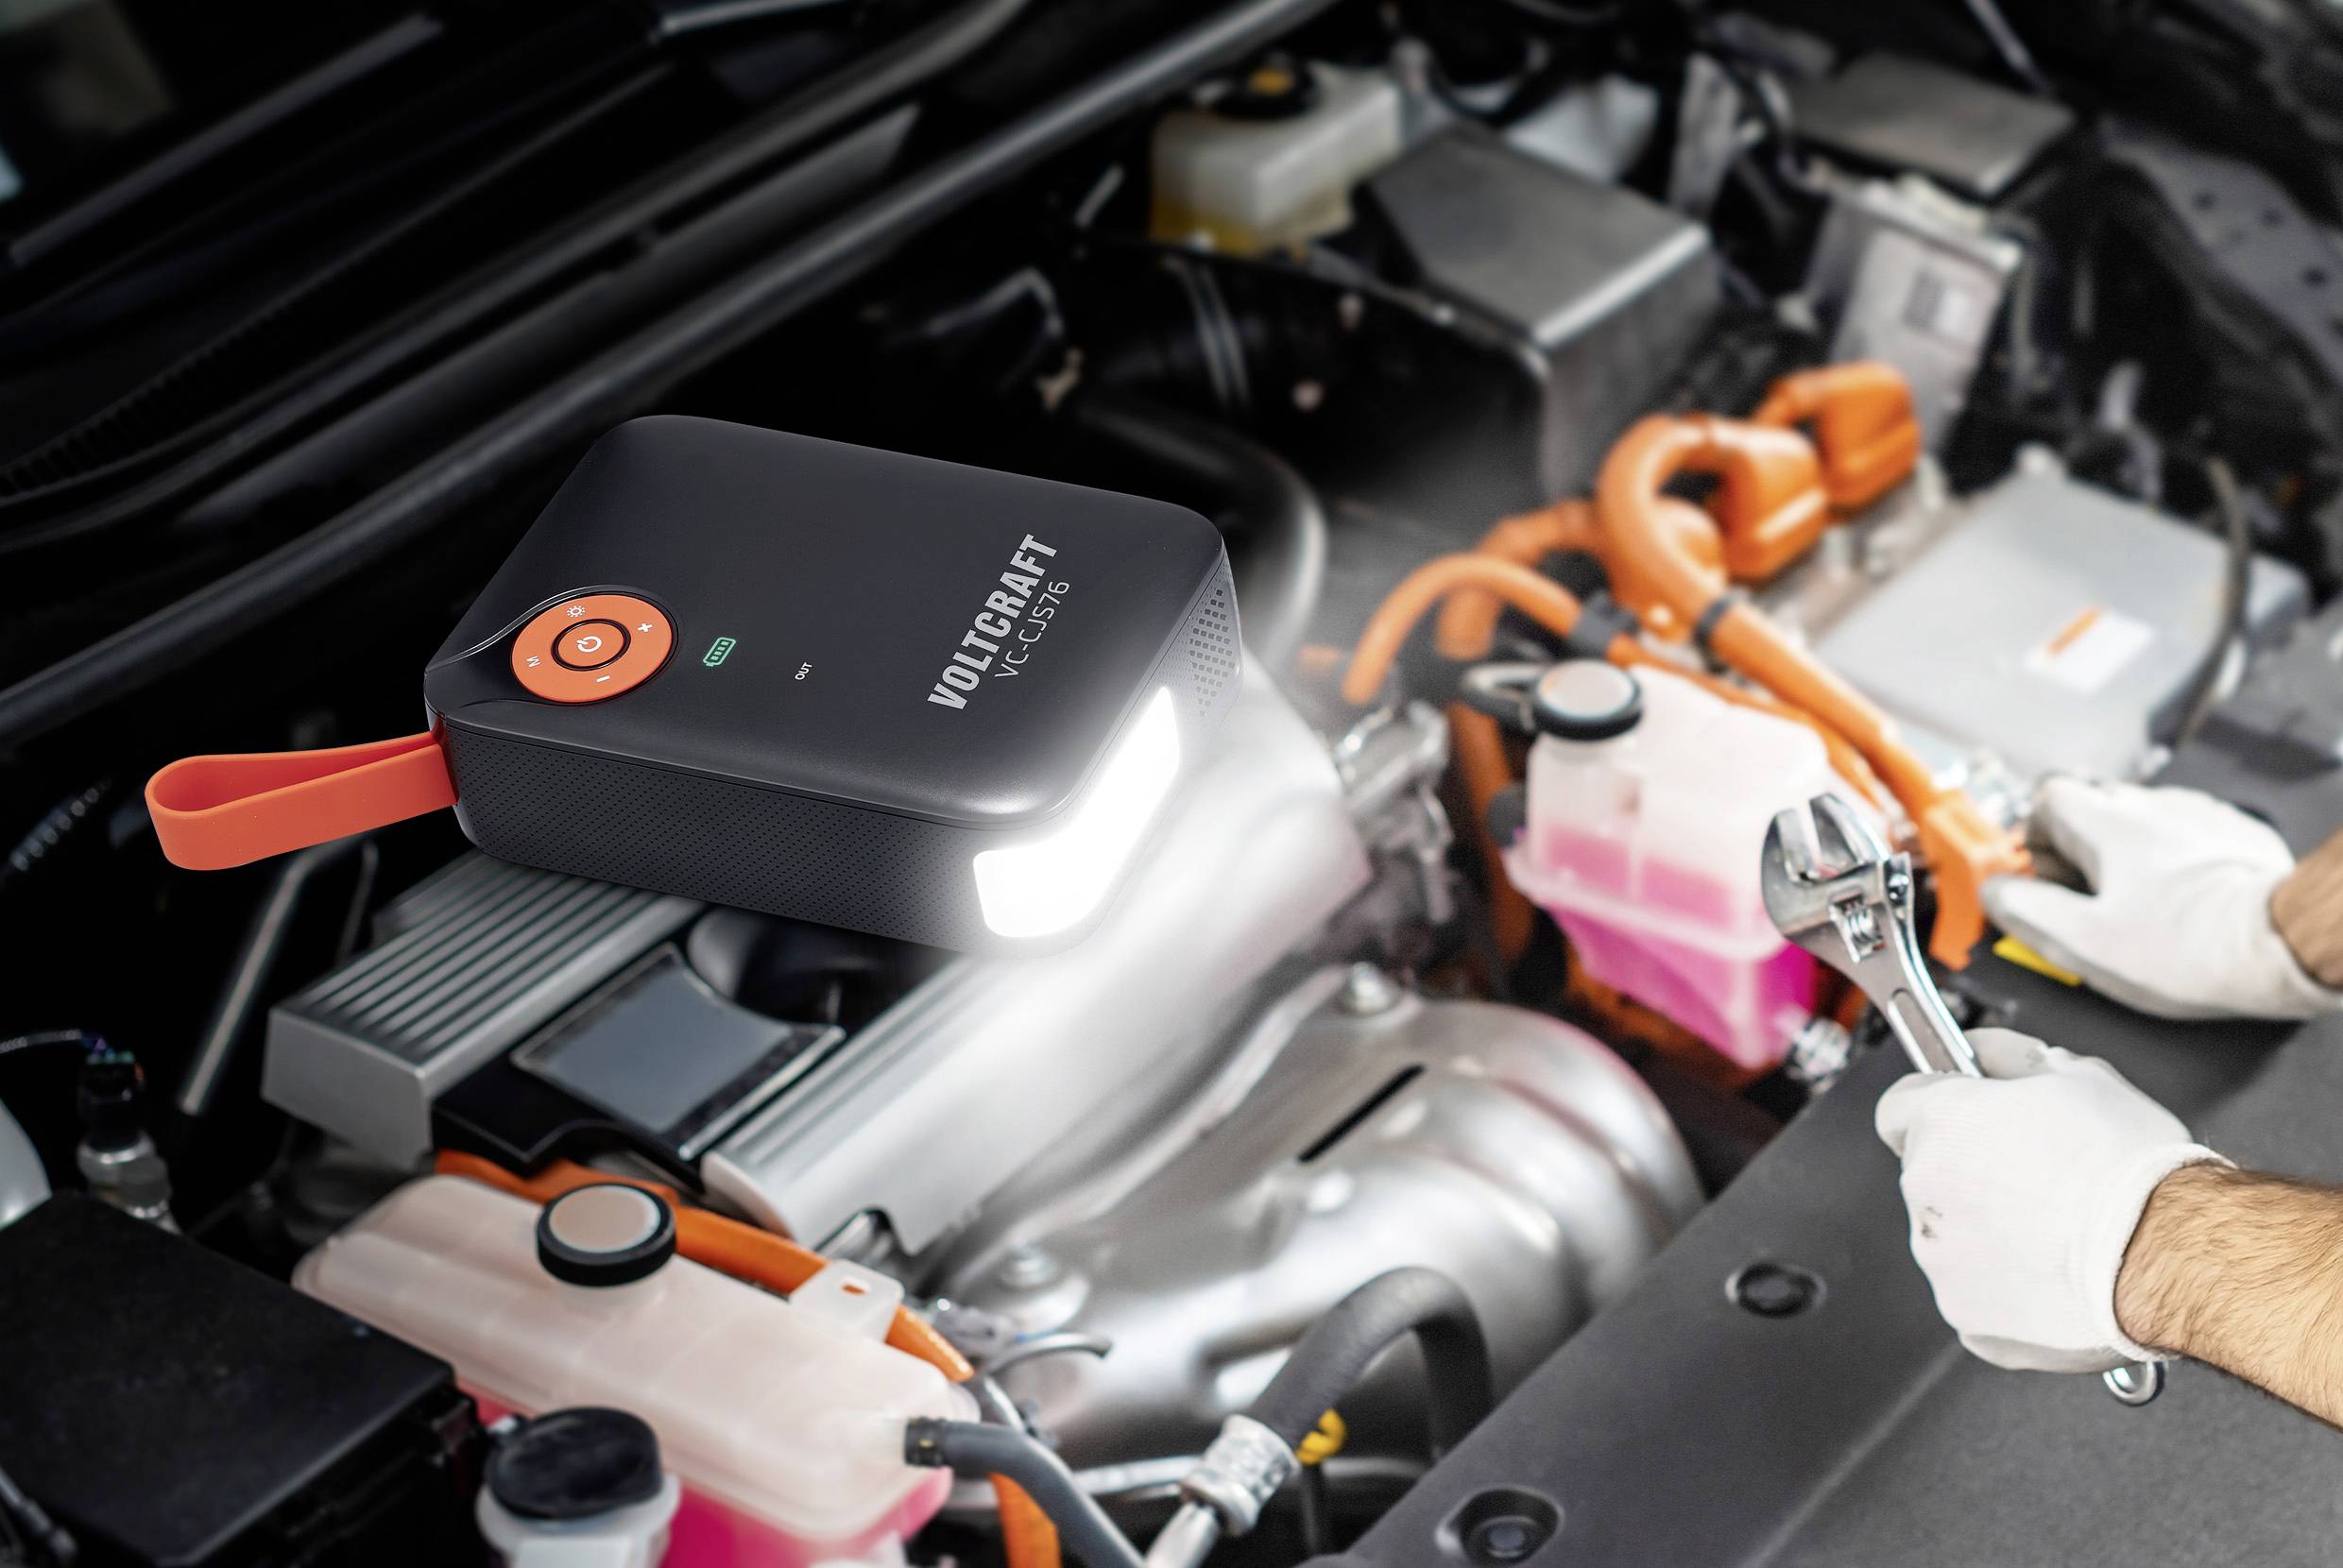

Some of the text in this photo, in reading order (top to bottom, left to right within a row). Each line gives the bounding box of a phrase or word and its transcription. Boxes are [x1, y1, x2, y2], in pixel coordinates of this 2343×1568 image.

[927, 533, 1057, 710] VOLTCRAFT
[994, 581, 1070, 678] VC-CJS76
[526, 656, 540, 668] M
[795, 661, 812, 681] OUT
